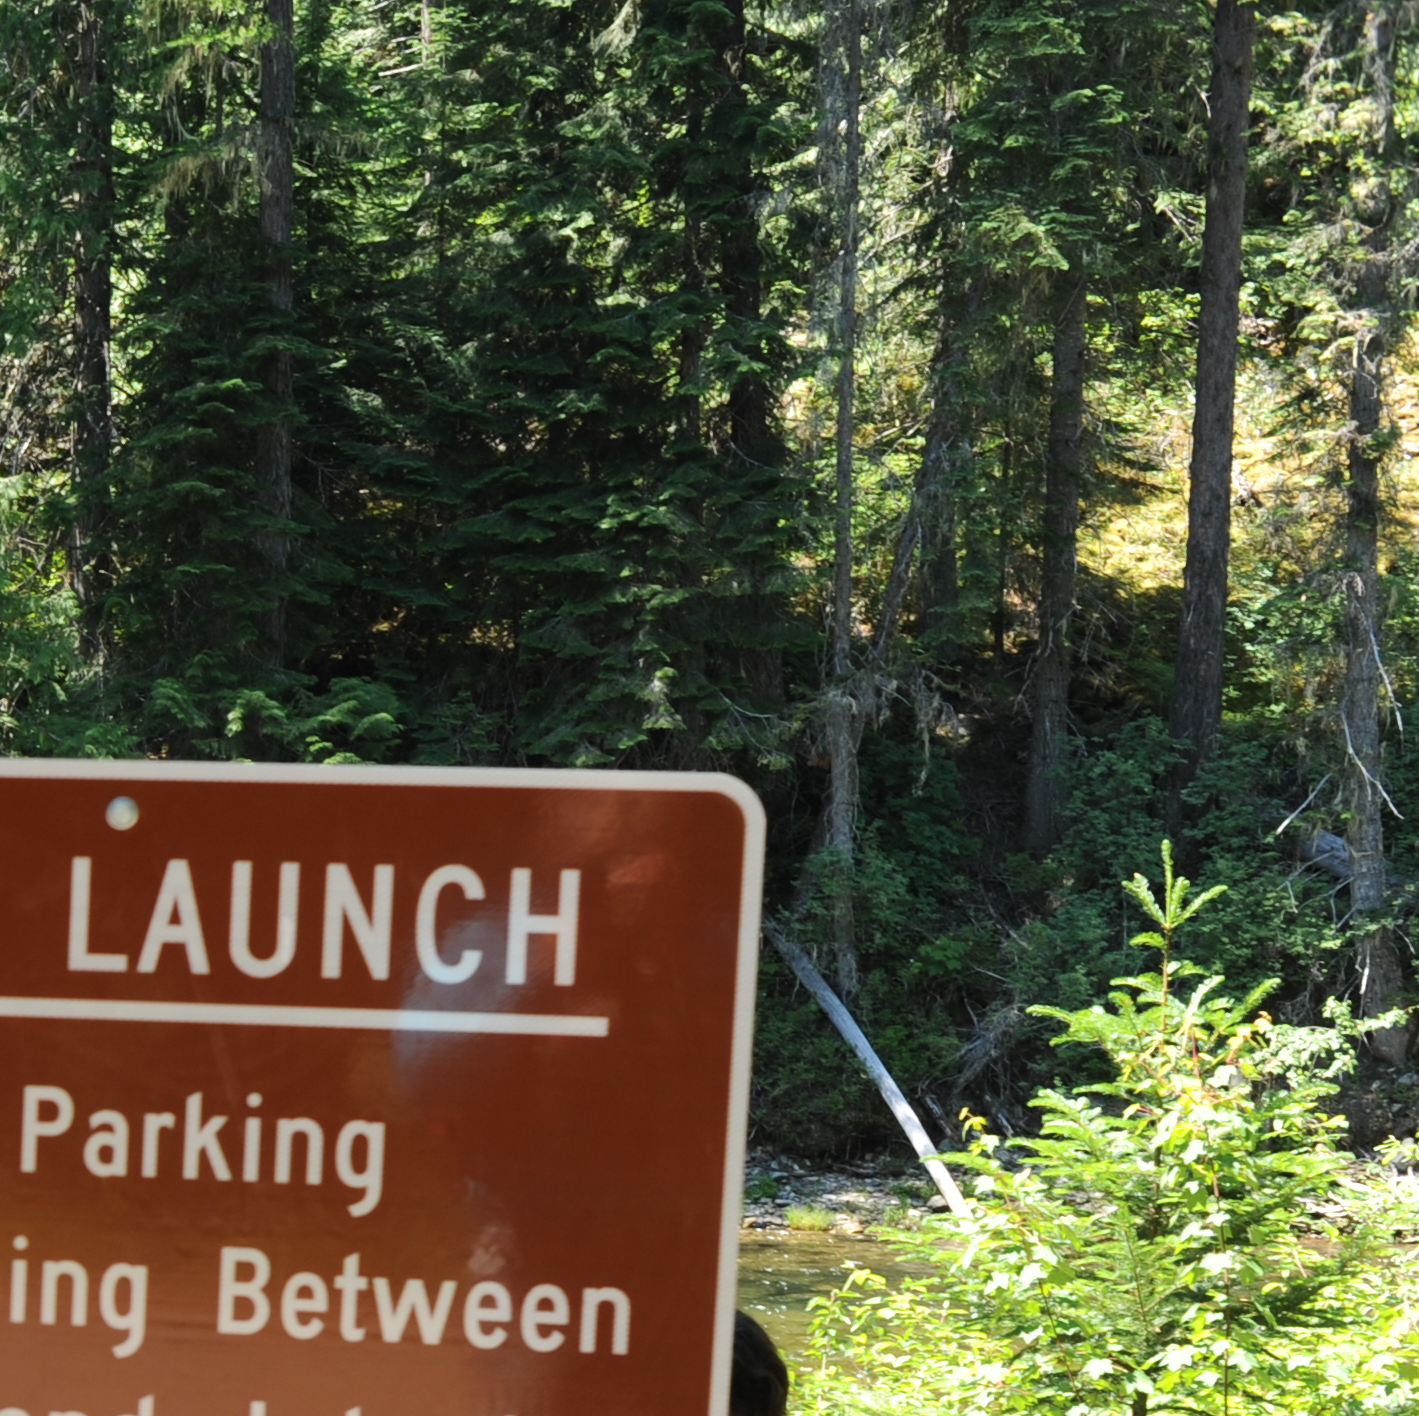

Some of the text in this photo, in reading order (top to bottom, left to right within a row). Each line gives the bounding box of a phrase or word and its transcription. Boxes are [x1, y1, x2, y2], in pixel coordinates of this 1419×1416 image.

[68, 856, 581, 986] LAUNCH
[20, 1085, 385, 1217] Parking
[217, 1246, 631, 1355] Between
